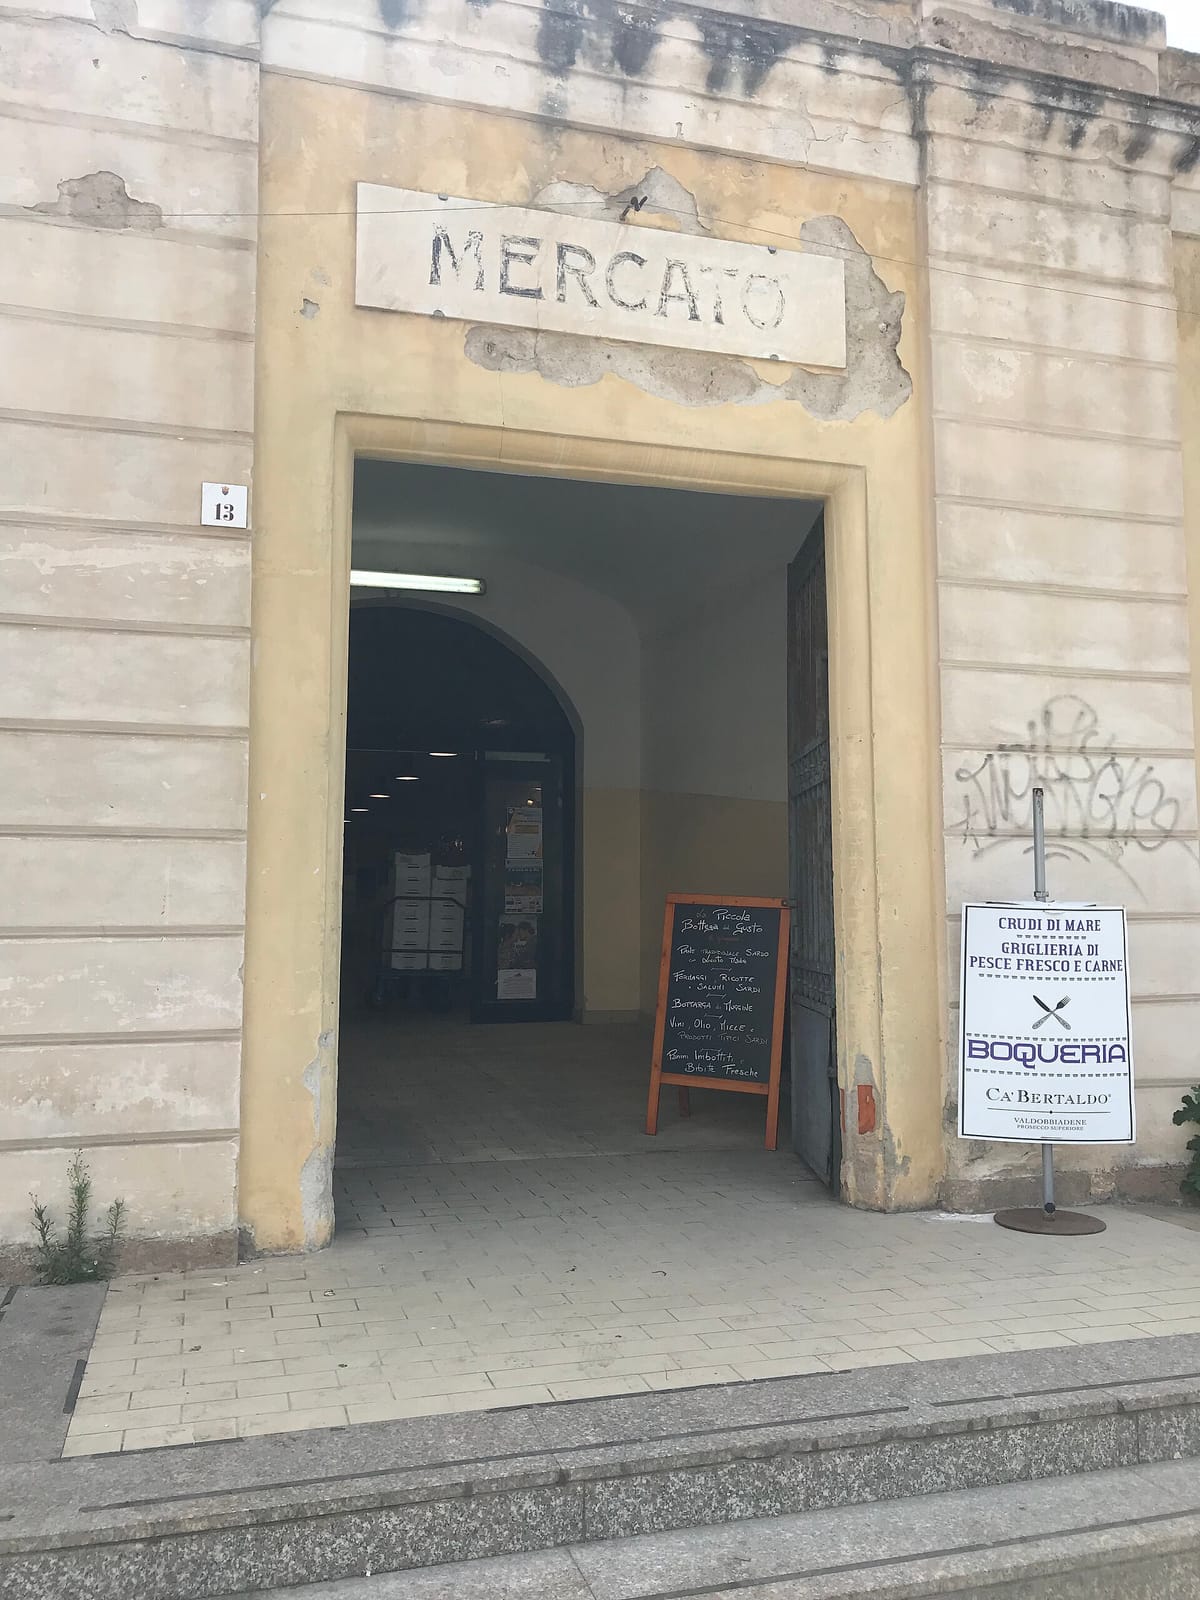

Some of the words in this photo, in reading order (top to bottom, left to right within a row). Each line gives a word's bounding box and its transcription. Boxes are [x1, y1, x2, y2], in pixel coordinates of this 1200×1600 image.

[428, 221, 787, 330] MERCATO
[215, 503, 234, 521] 13
[713, 908, 751, 921] Piccola
[681, 919, 719, 933] Bottega
[732, 922, 763, 936] Gusto
[998, 917, 1042, 931] CRUDI
[1047, 919, 1061, 931] DI
[1065, 919, 1101, 932] MARE
[1001, 942, 1083, 957] GRIGLIERIA
[1087, 944, 1099, 956] DI
[969, 956, 1012, 970] PESCE
[1016, 958, 1070, 972] FRESCO
[1074, 960, 1082, 972] E
[1085, 959, 1123, 972] CARNE
[671, 998, 711, 1009] BOTTARGA
[967, 1039, 1127, 1070] BOQUERIA
[722, 1064, 759, 1078] Fresche
[1014, 1117, 1087, 1126] VALDOBBIADENE
